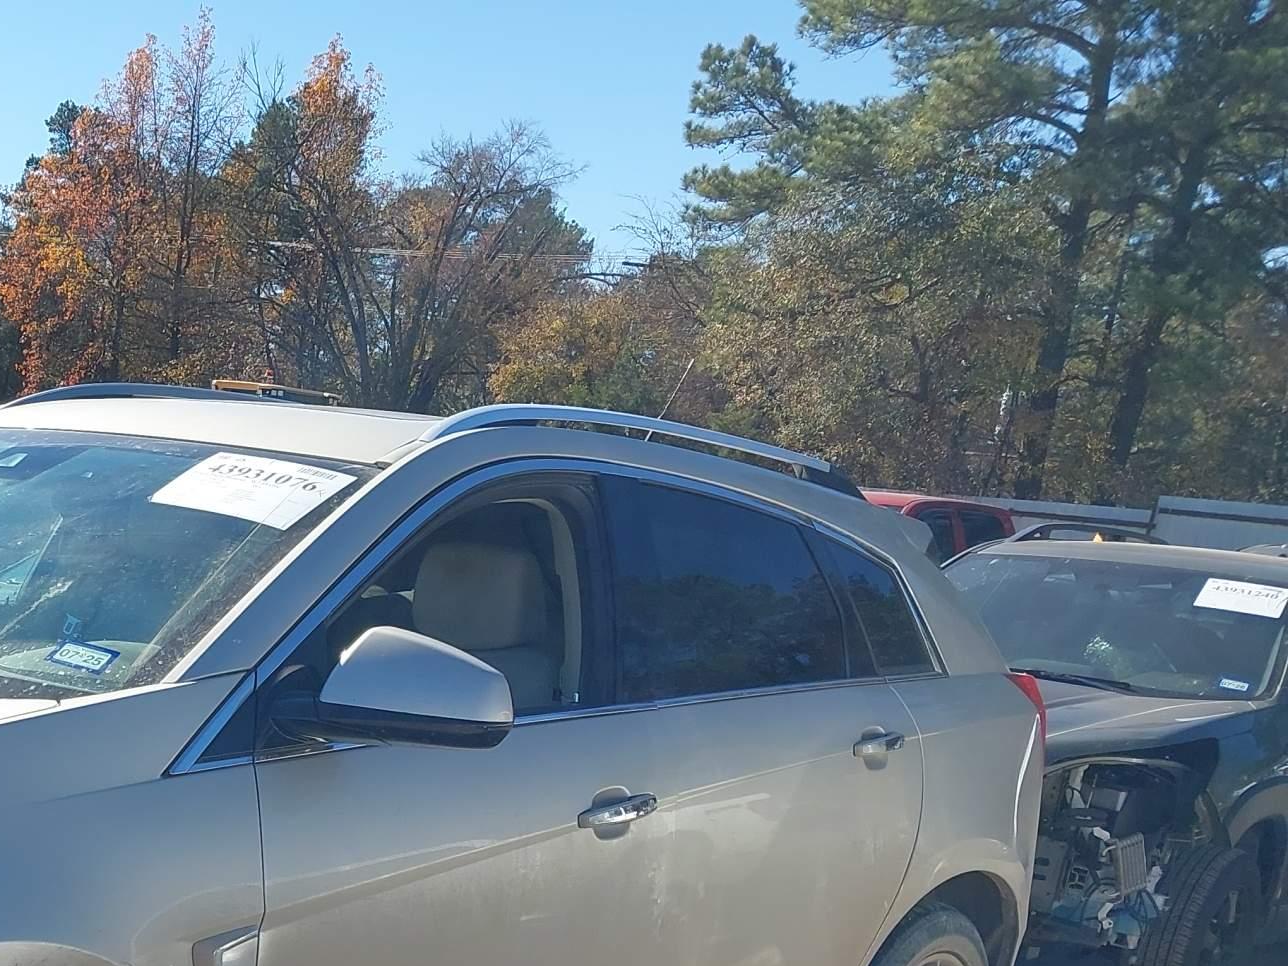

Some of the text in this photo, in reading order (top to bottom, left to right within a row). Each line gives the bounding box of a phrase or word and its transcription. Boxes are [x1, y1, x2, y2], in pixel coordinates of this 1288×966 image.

[208, 463, 321, 492] 43931076
[59, 648, 104, 666] 07 25
